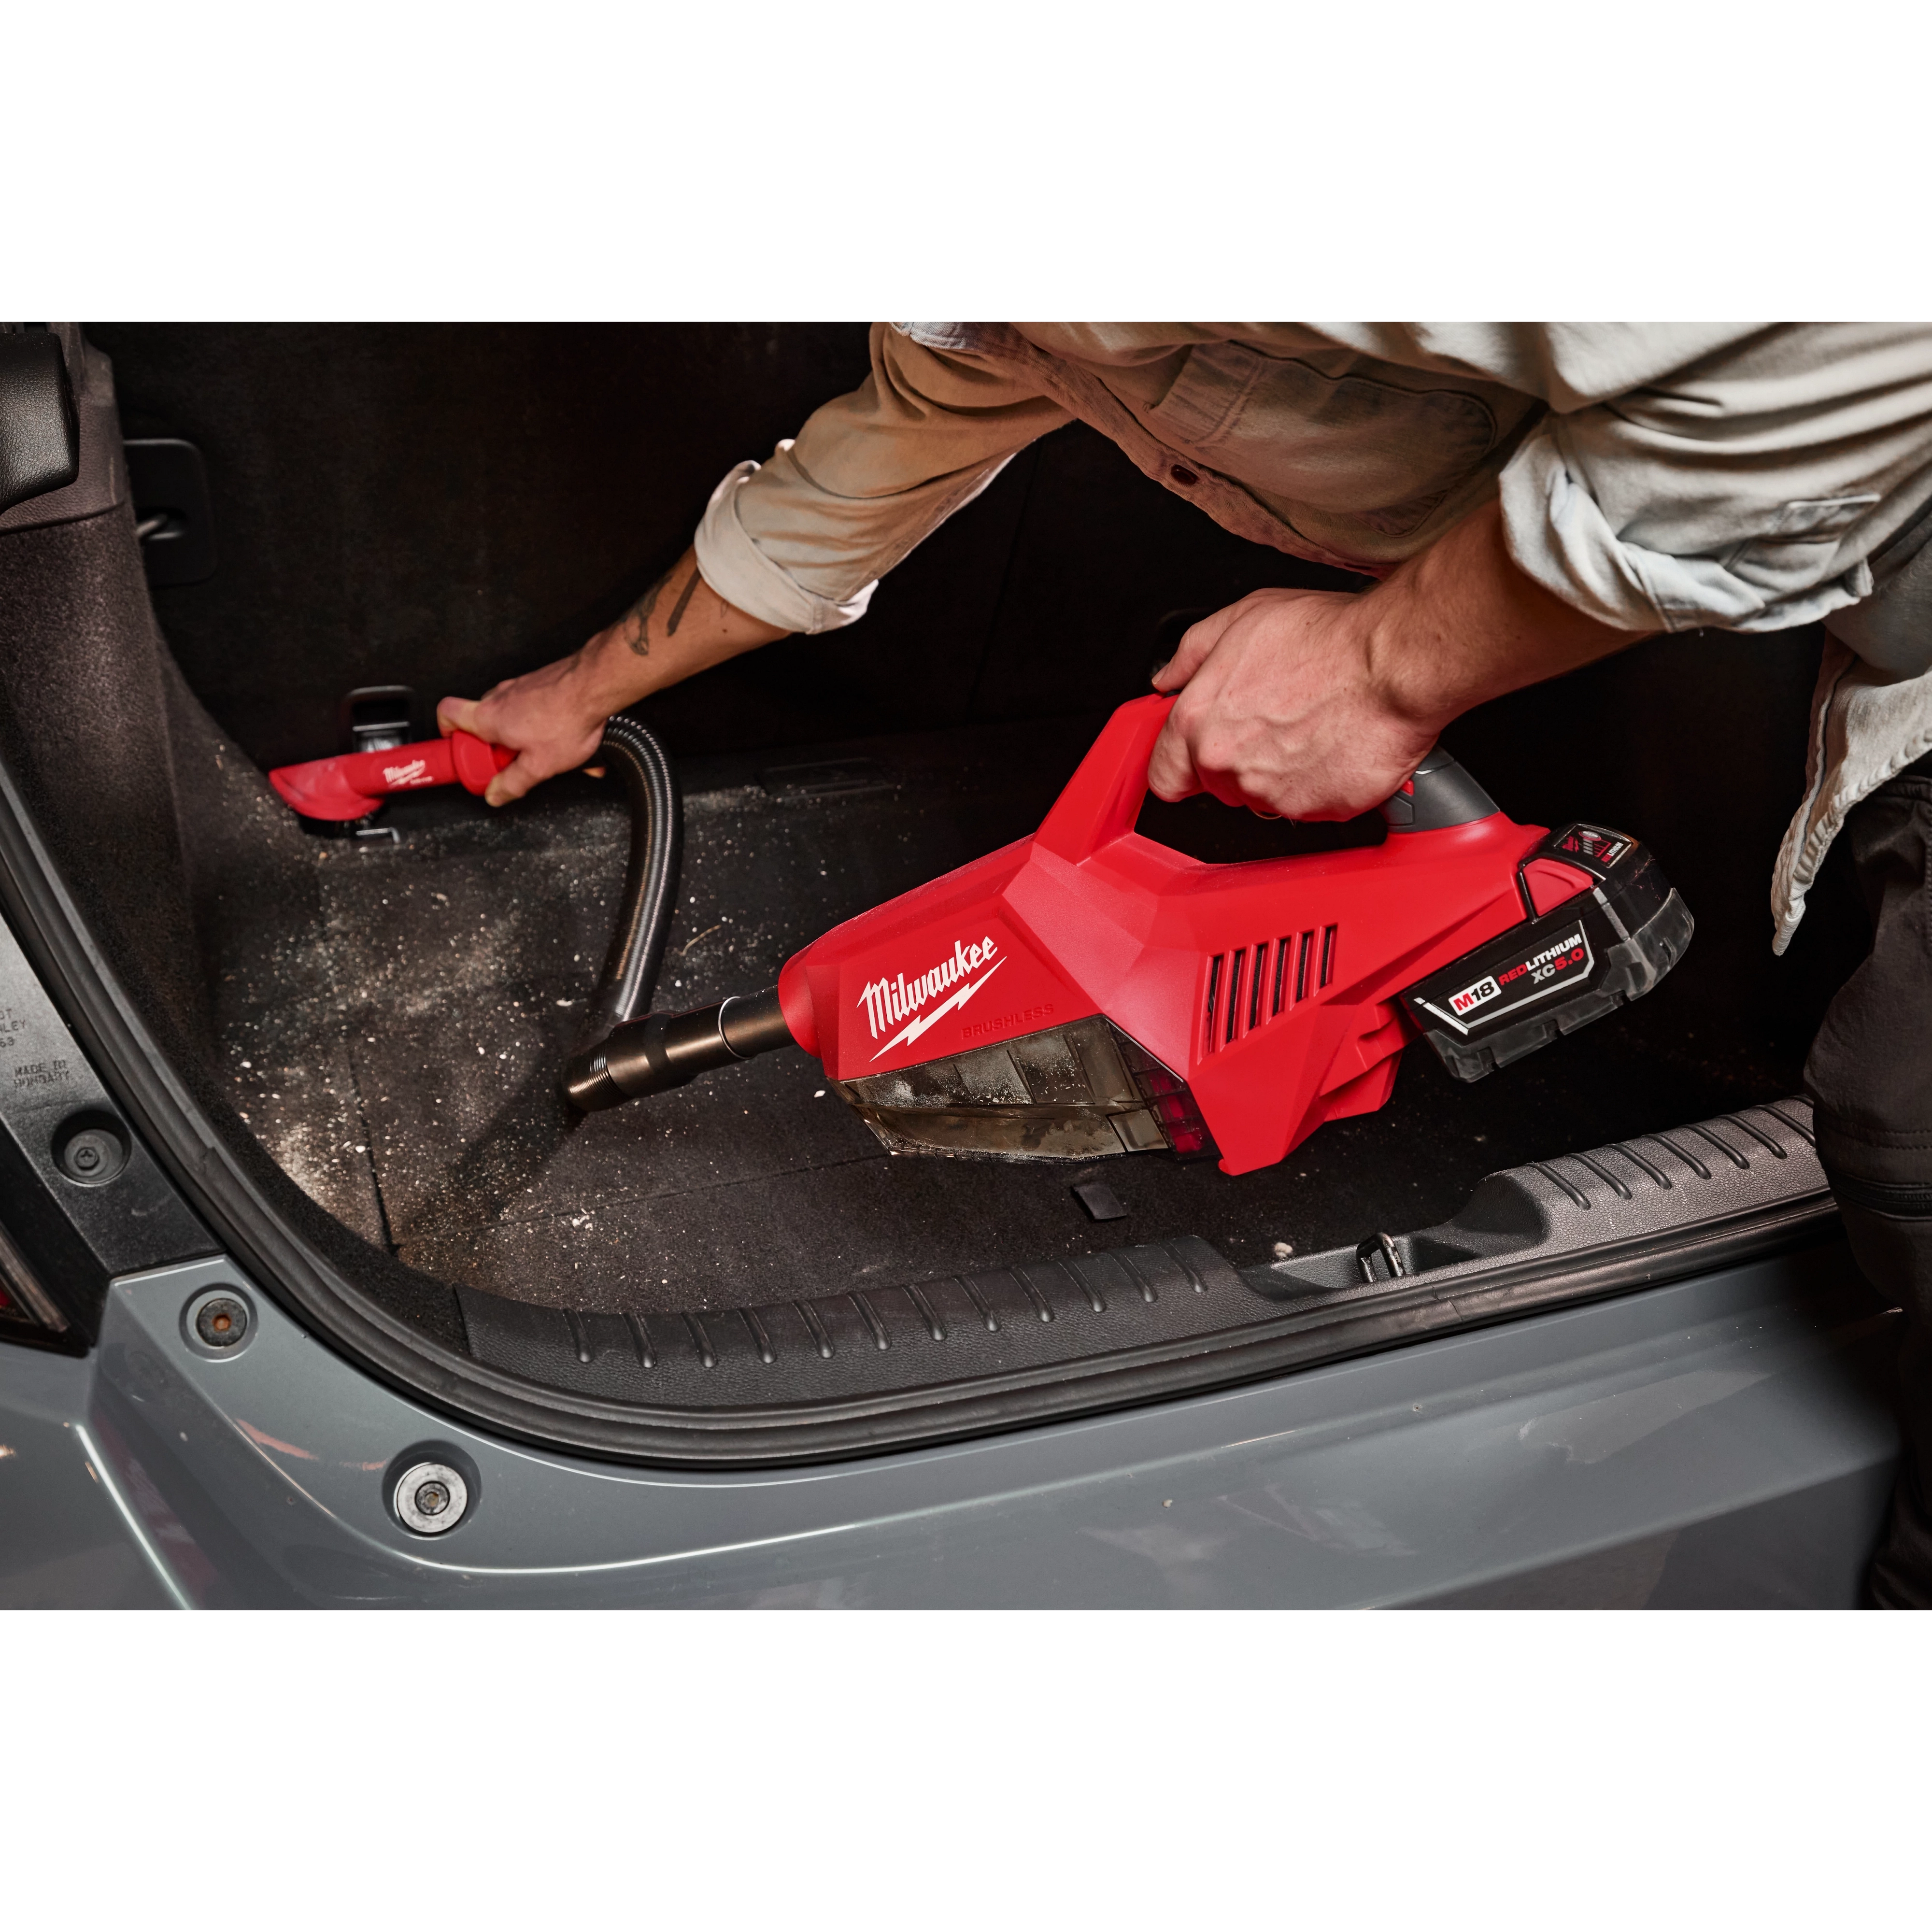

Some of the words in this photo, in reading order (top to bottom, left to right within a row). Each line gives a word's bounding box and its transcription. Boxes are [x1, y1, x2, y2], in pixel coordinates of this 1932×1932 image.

[1498, 933, 1582, 985] REDLITHIUM
[1531, 948, 1584, 984] XC5.0
[856, 936, 997, 1039] Milwaukee
[1453, 981, 1494, 1011] M18
[961, 1003, 1054, 1039] BRUSHLESS
[14, 1063, 47, 1078] MADE
